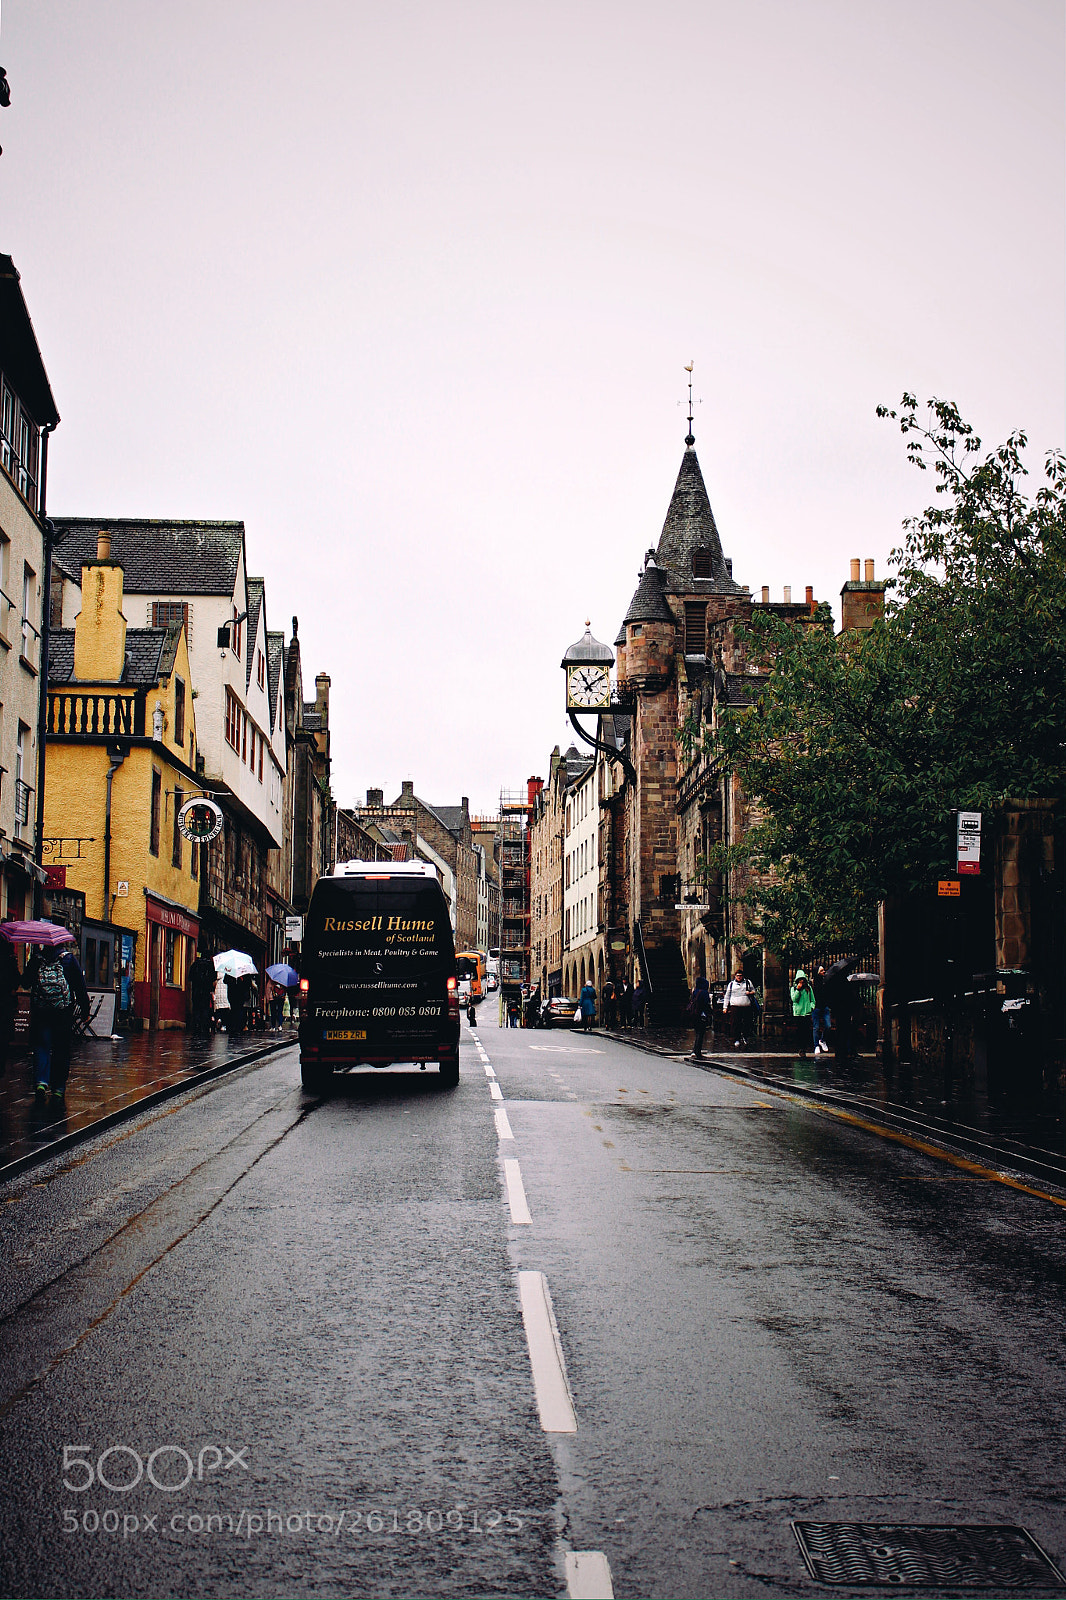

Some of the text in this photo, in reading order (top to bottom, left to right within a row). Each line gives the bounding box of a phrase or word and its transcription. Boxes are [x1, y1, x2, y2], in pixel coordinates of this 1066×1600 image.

[324, 916, 435, 931] Russell Hume
[385, 933, 435, 945] of Scotland
[318, 949, 354, 959] Specialists
[363, 949, 383, 957] Meat,
[384, 949, 410, 958] Poultry
[411, 948, 418, 956] &
[419, 948, 439, 956] Game
[338, 981, 418, 990] www.russellhume.com
[314, 1005, 442, 1020] Freephone: 0800 085 0801
[350, 1030, 366, 1039] ZRL
